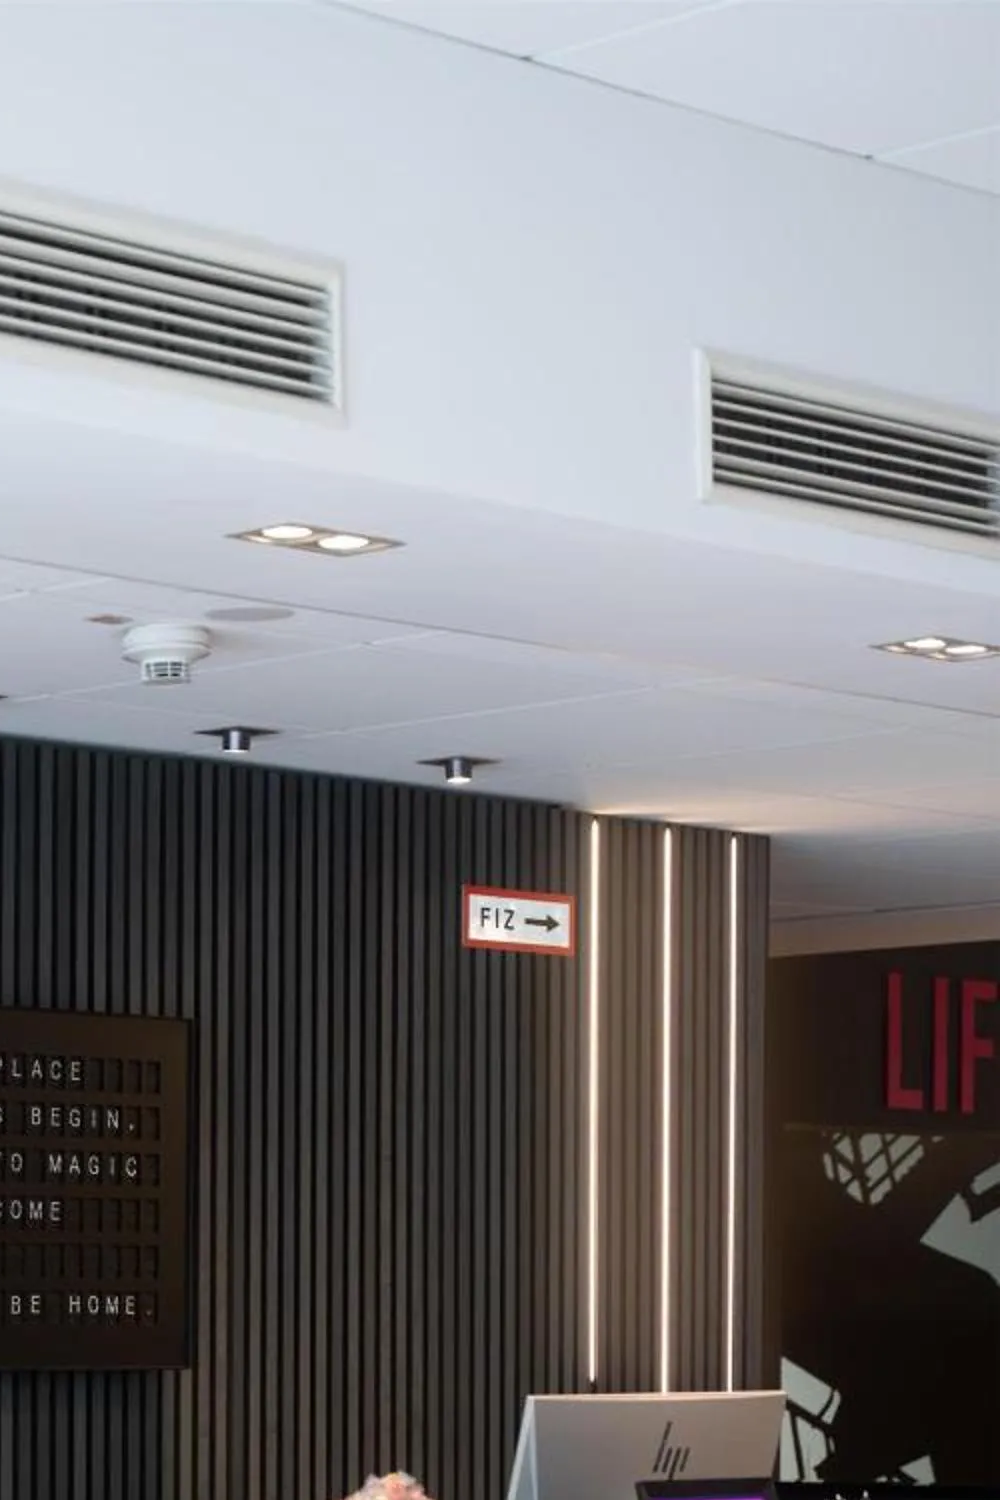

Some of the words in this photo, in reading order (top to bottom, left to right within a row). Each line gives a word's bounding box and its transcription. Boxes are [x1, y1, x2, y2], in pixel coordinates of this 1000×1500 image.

[480, 906, 516, 932] FIZ
[48, 1155, 139, 1178] MAGIC
[10, 1295, 42, 1315] BE
[68, 1295, 154, 1317] HOME.
